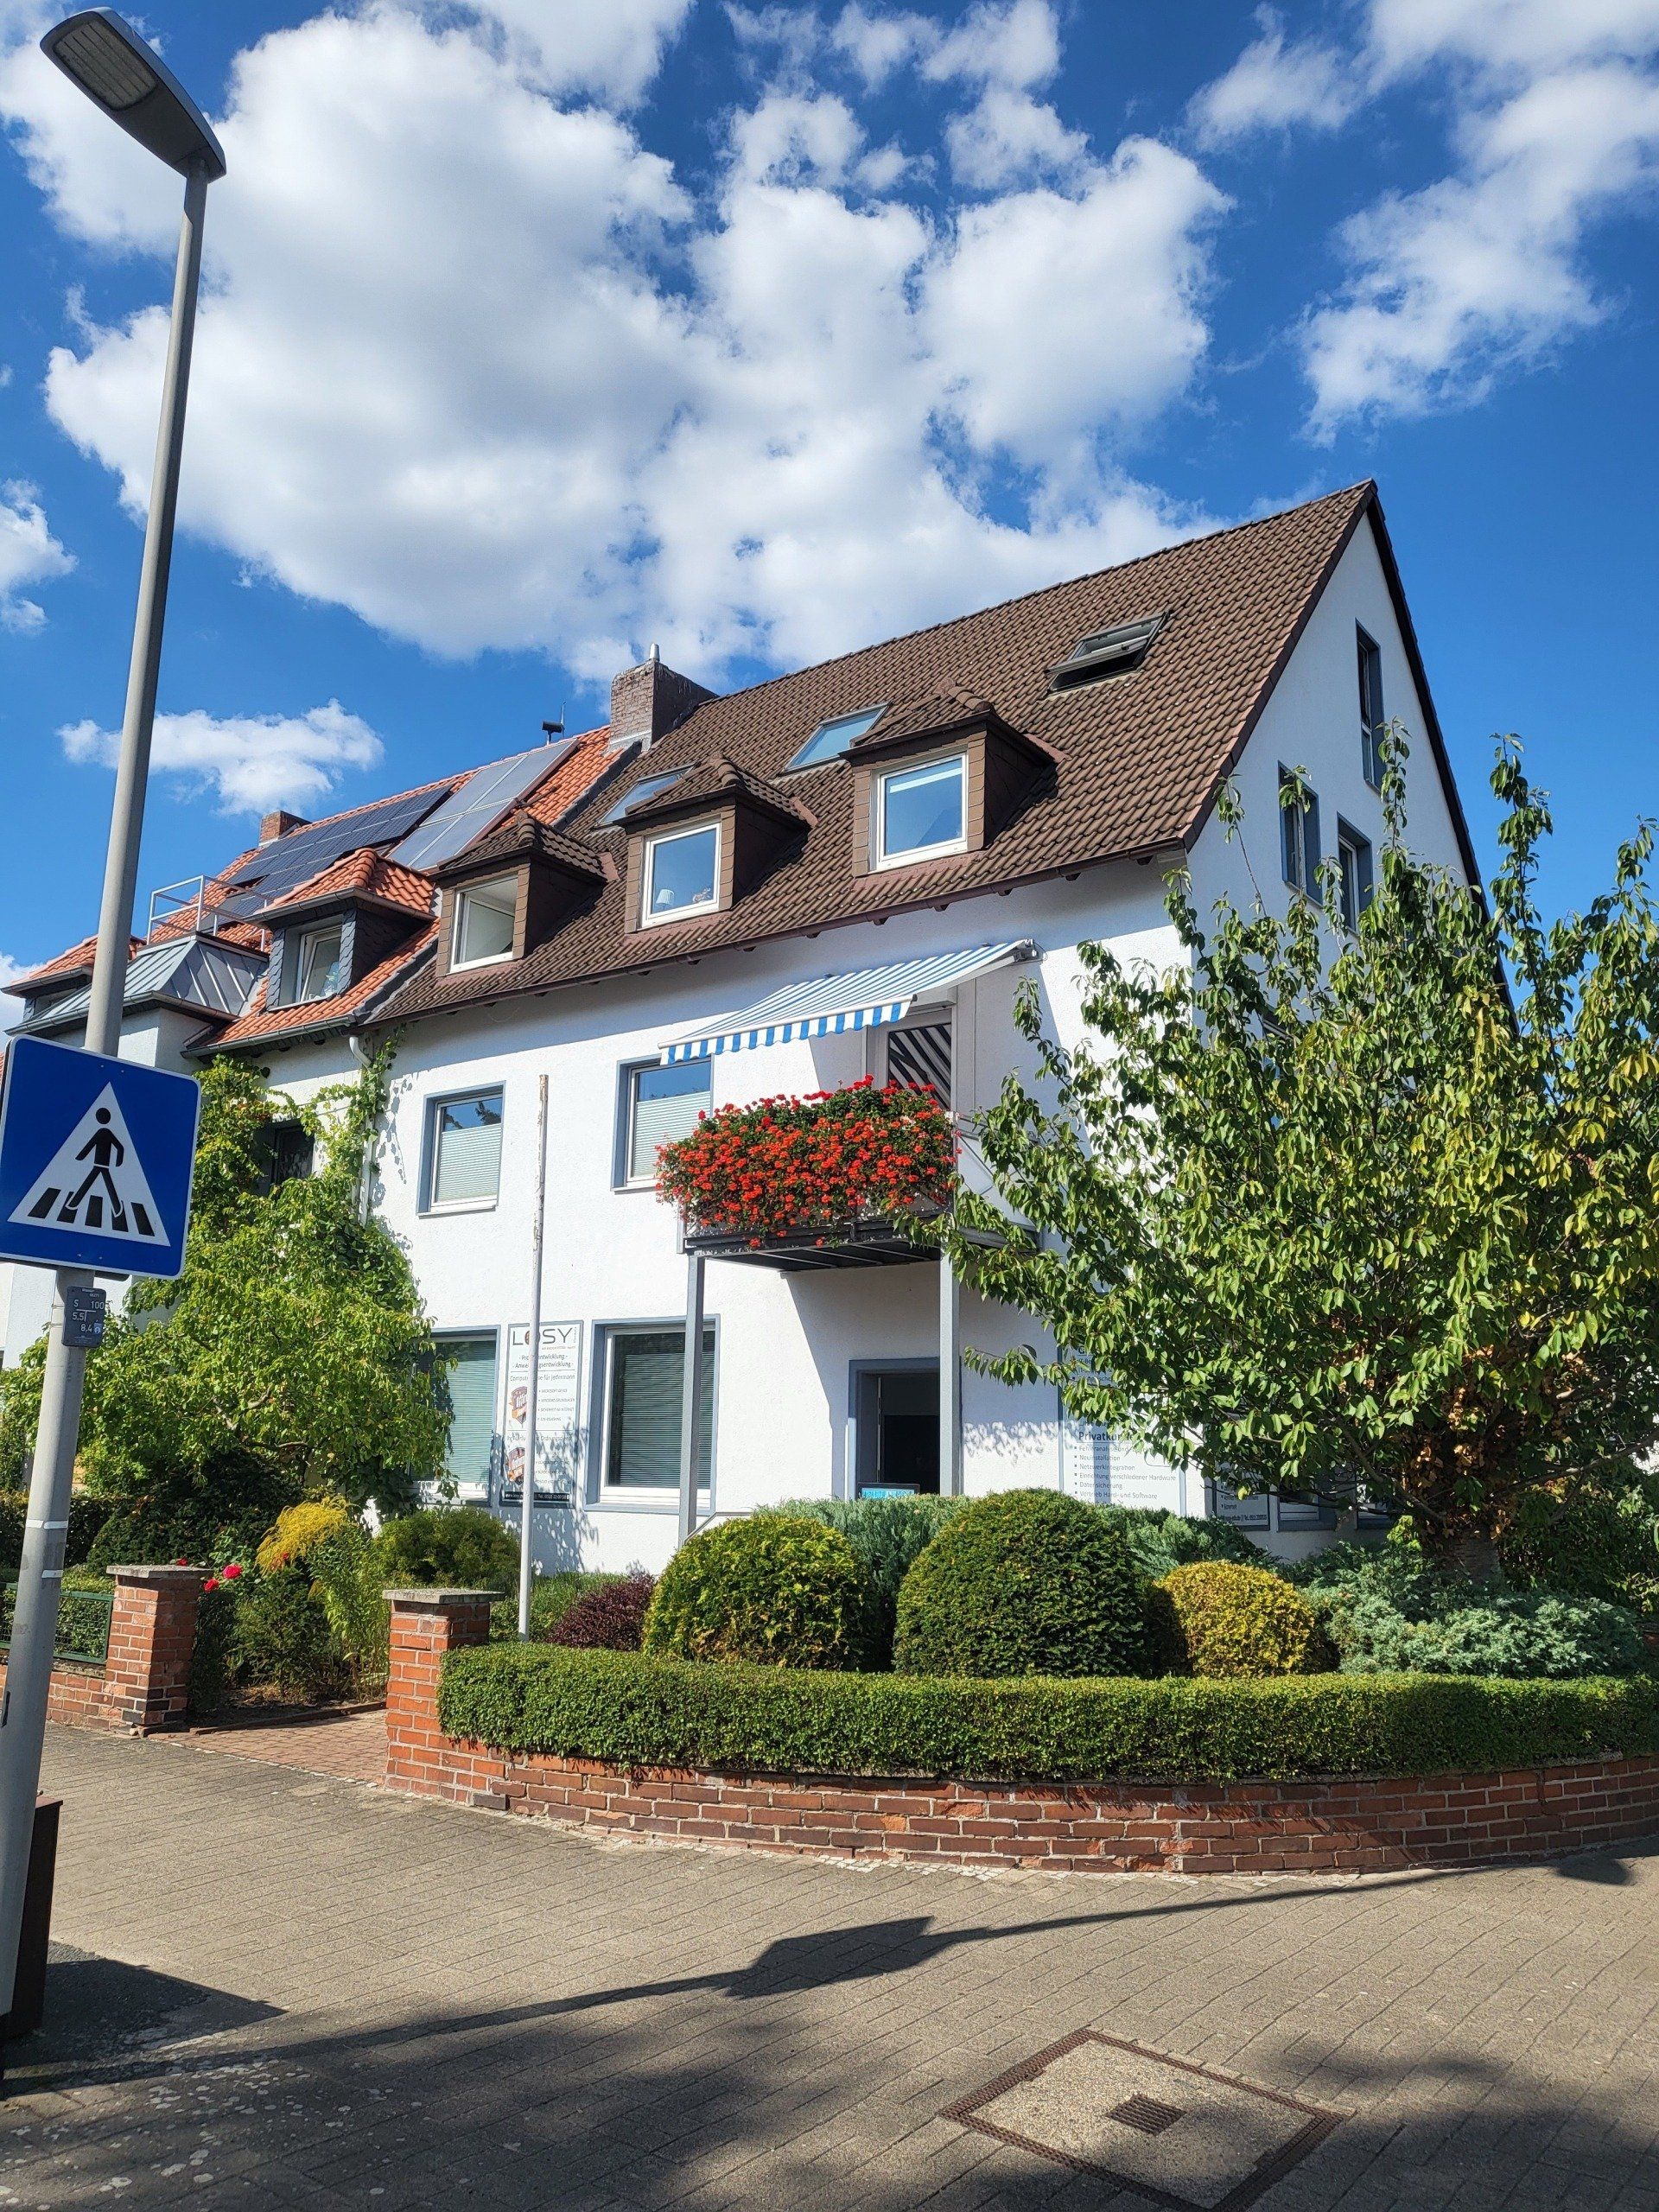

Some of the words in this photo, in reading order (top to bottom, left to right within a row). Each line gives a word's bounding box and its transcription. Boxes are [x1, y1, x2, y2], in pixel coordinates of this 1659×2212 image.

[73, 1299, 79, 1307] S
[91, 1300, 105, 1310] 100
[1079, 1471, 1109, 1480] Einrichtung
